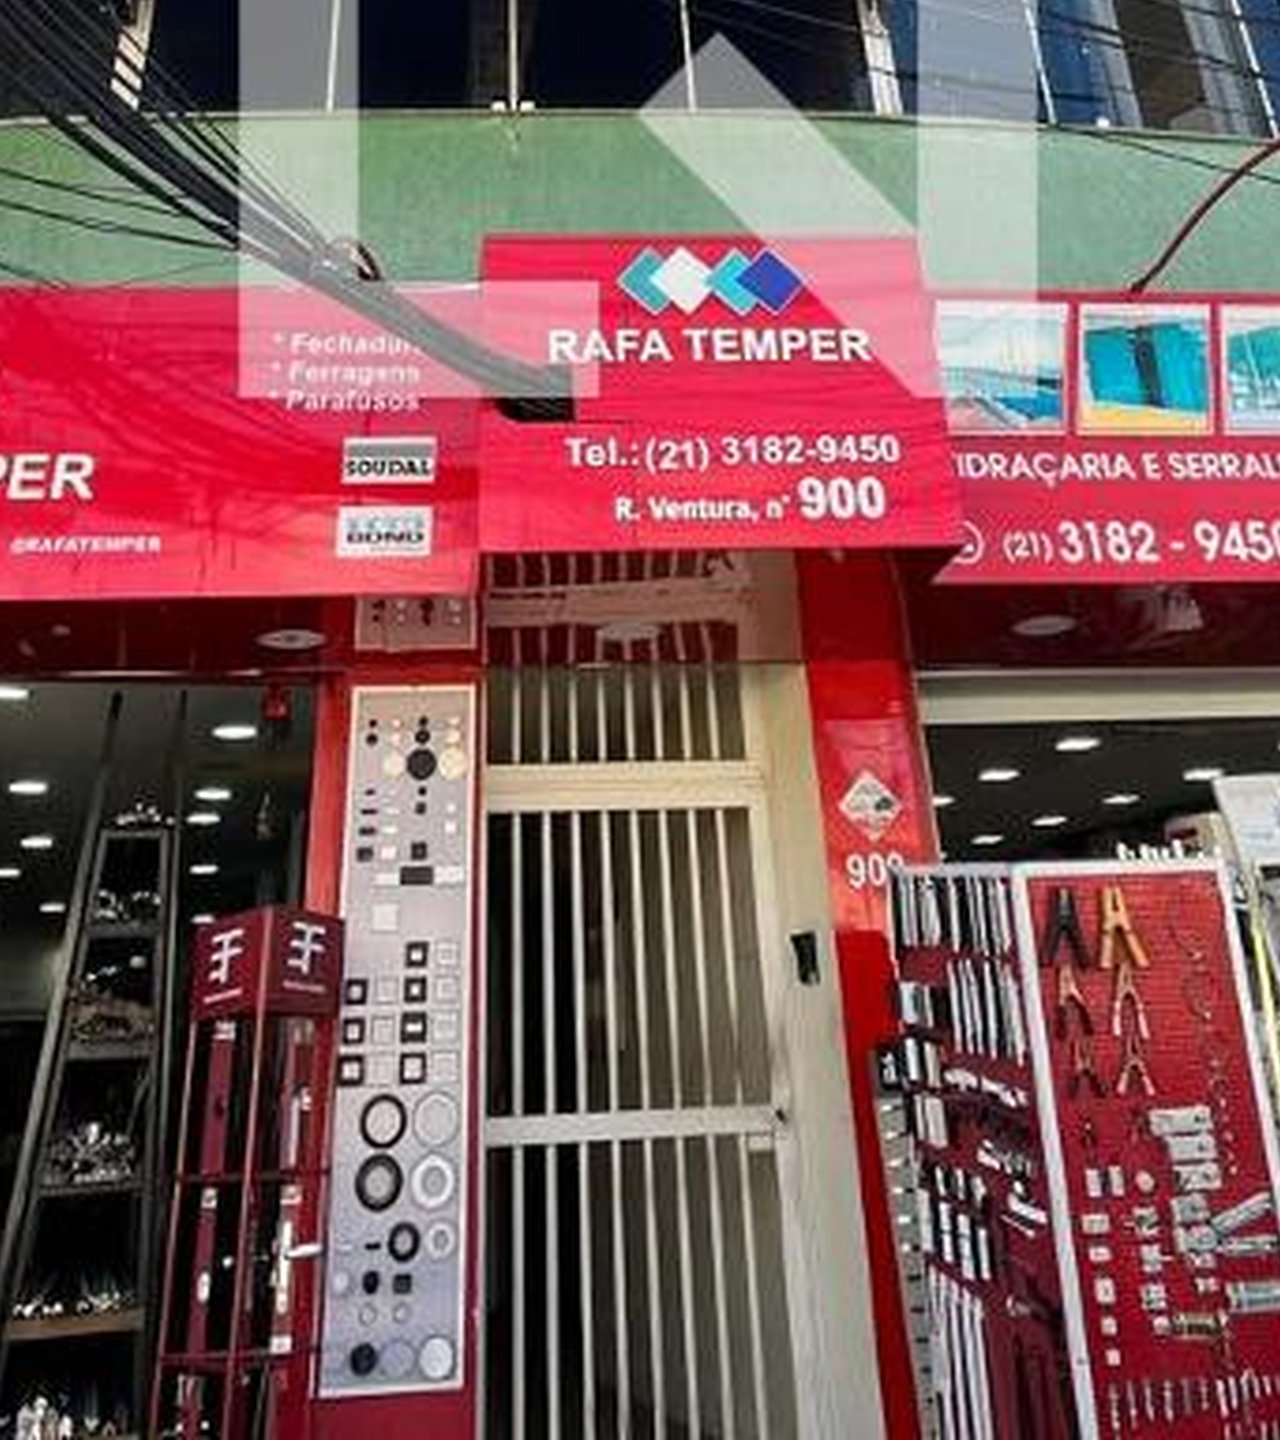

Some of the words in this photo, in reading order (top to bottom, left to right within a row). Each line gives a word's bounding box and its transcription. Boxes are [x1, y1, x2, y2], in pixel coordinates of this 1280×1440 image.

[549, 329, 673, 361] RAFA
[685, 328, 871, 361] TEMPER
[286, 389, 421, 411] Parafusos
[721, 434, 900, 464] 3182-9450
[345, 461, 431, 476] SOUDAL
[951, 452, 1136, 488] IDRAÇARIA
[1144, 452, 1161, 479] E
[614, 498, 639, 520] R.
[649, 497, 759, 523] Ventura,
[799, 477, 885, 519] 900
[1003, 532, 1052, 564] (21)
[1058, 521, 1160, 561] 3182
